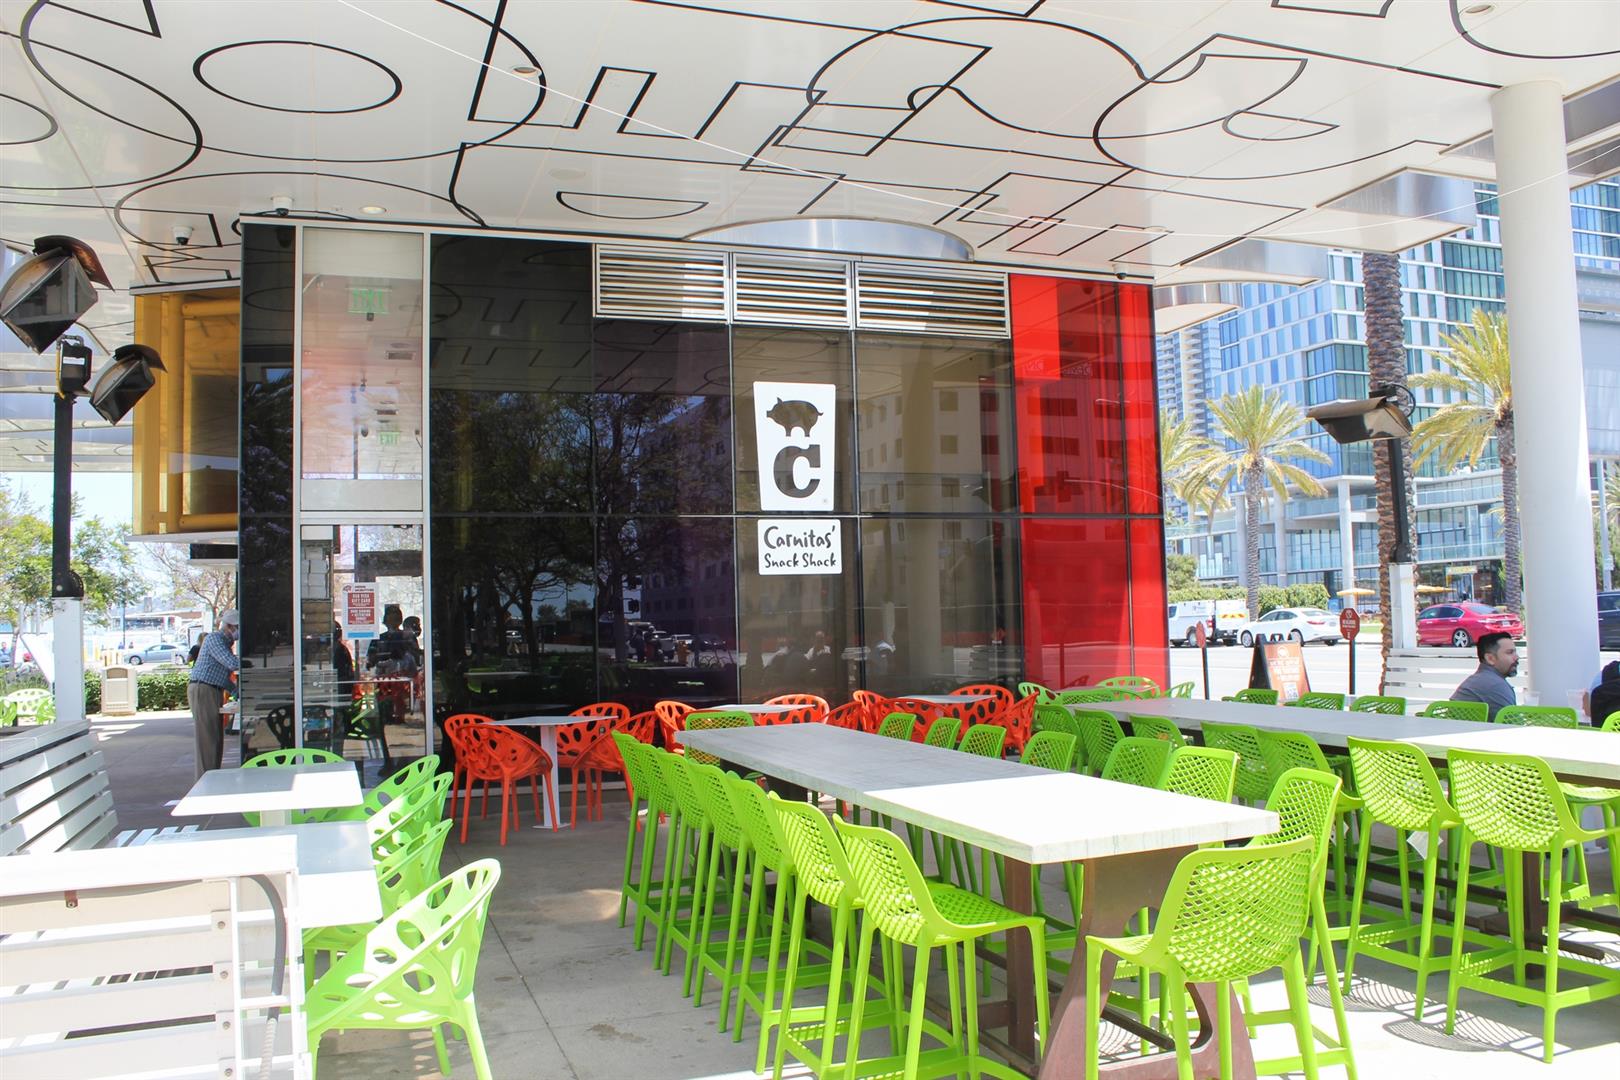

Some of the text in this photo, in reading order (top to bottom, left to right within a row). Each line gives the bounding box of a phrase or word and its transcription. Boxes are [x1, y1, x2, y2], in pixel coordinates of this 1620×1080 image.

[773, 444, 821, 499] C
[763, 525, 836, 549] Carnitas'
[764, 552, 837, 568] Snack Shack
